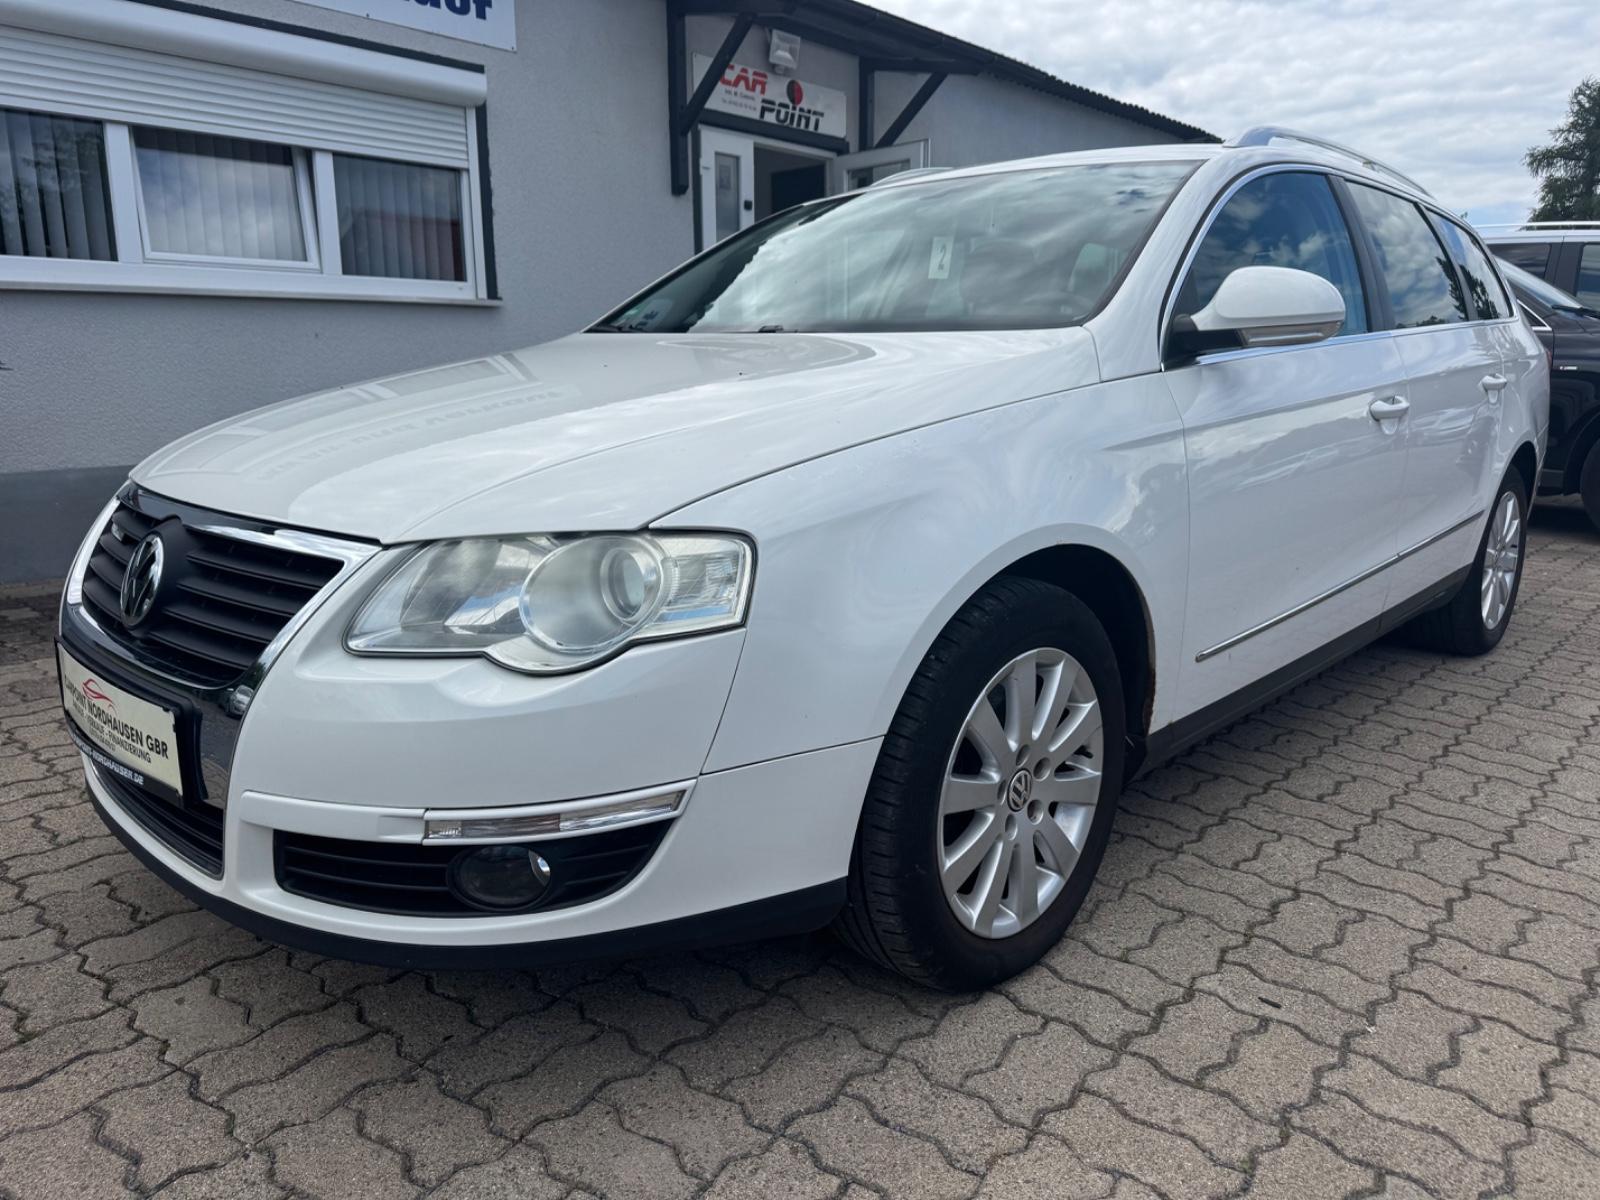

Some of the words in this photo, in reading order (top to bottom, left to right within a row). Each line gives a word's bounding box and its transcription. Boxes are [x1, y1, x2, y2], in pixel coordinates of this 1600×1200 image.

[720, 64, 768, 96] CAR
[759, 98, 825, 132] POINT
[88, 700, 144, 747] NORDHAUSEN
[146, 734, 169, 760] GBR
